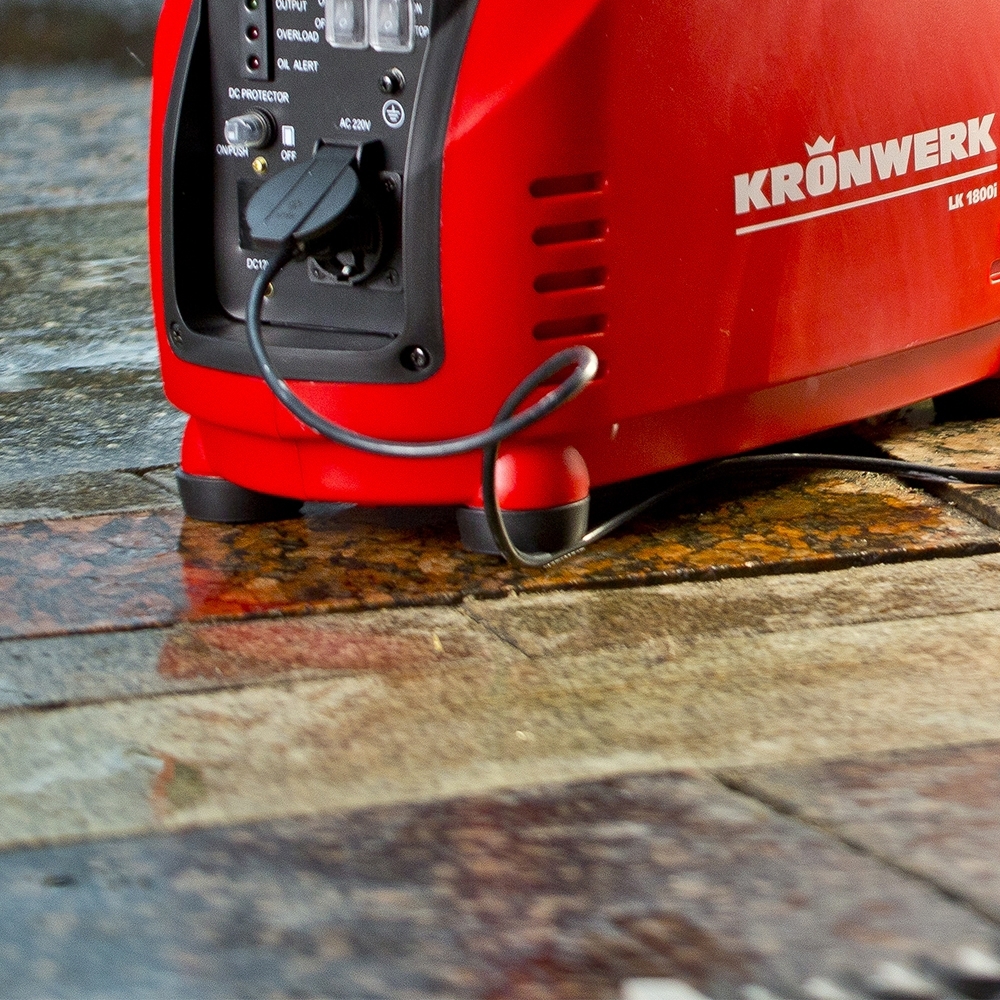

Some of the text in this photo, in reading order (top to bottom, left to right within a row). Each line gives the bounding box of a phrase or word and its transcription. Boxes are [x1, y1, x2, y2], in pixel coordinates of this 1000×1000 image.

[276, 27, 320, 43] OVERLOAD
[413, 24, 430, 39] TOP
[276, 57, 319, 72] OIL ALERT
[228, 86, 290, 104] DC PROTECTOR
[339, 117, 352, 131] AC
[280, 149, 297, 162] OFF
[948, 181, 999, 211] LK 1800i
